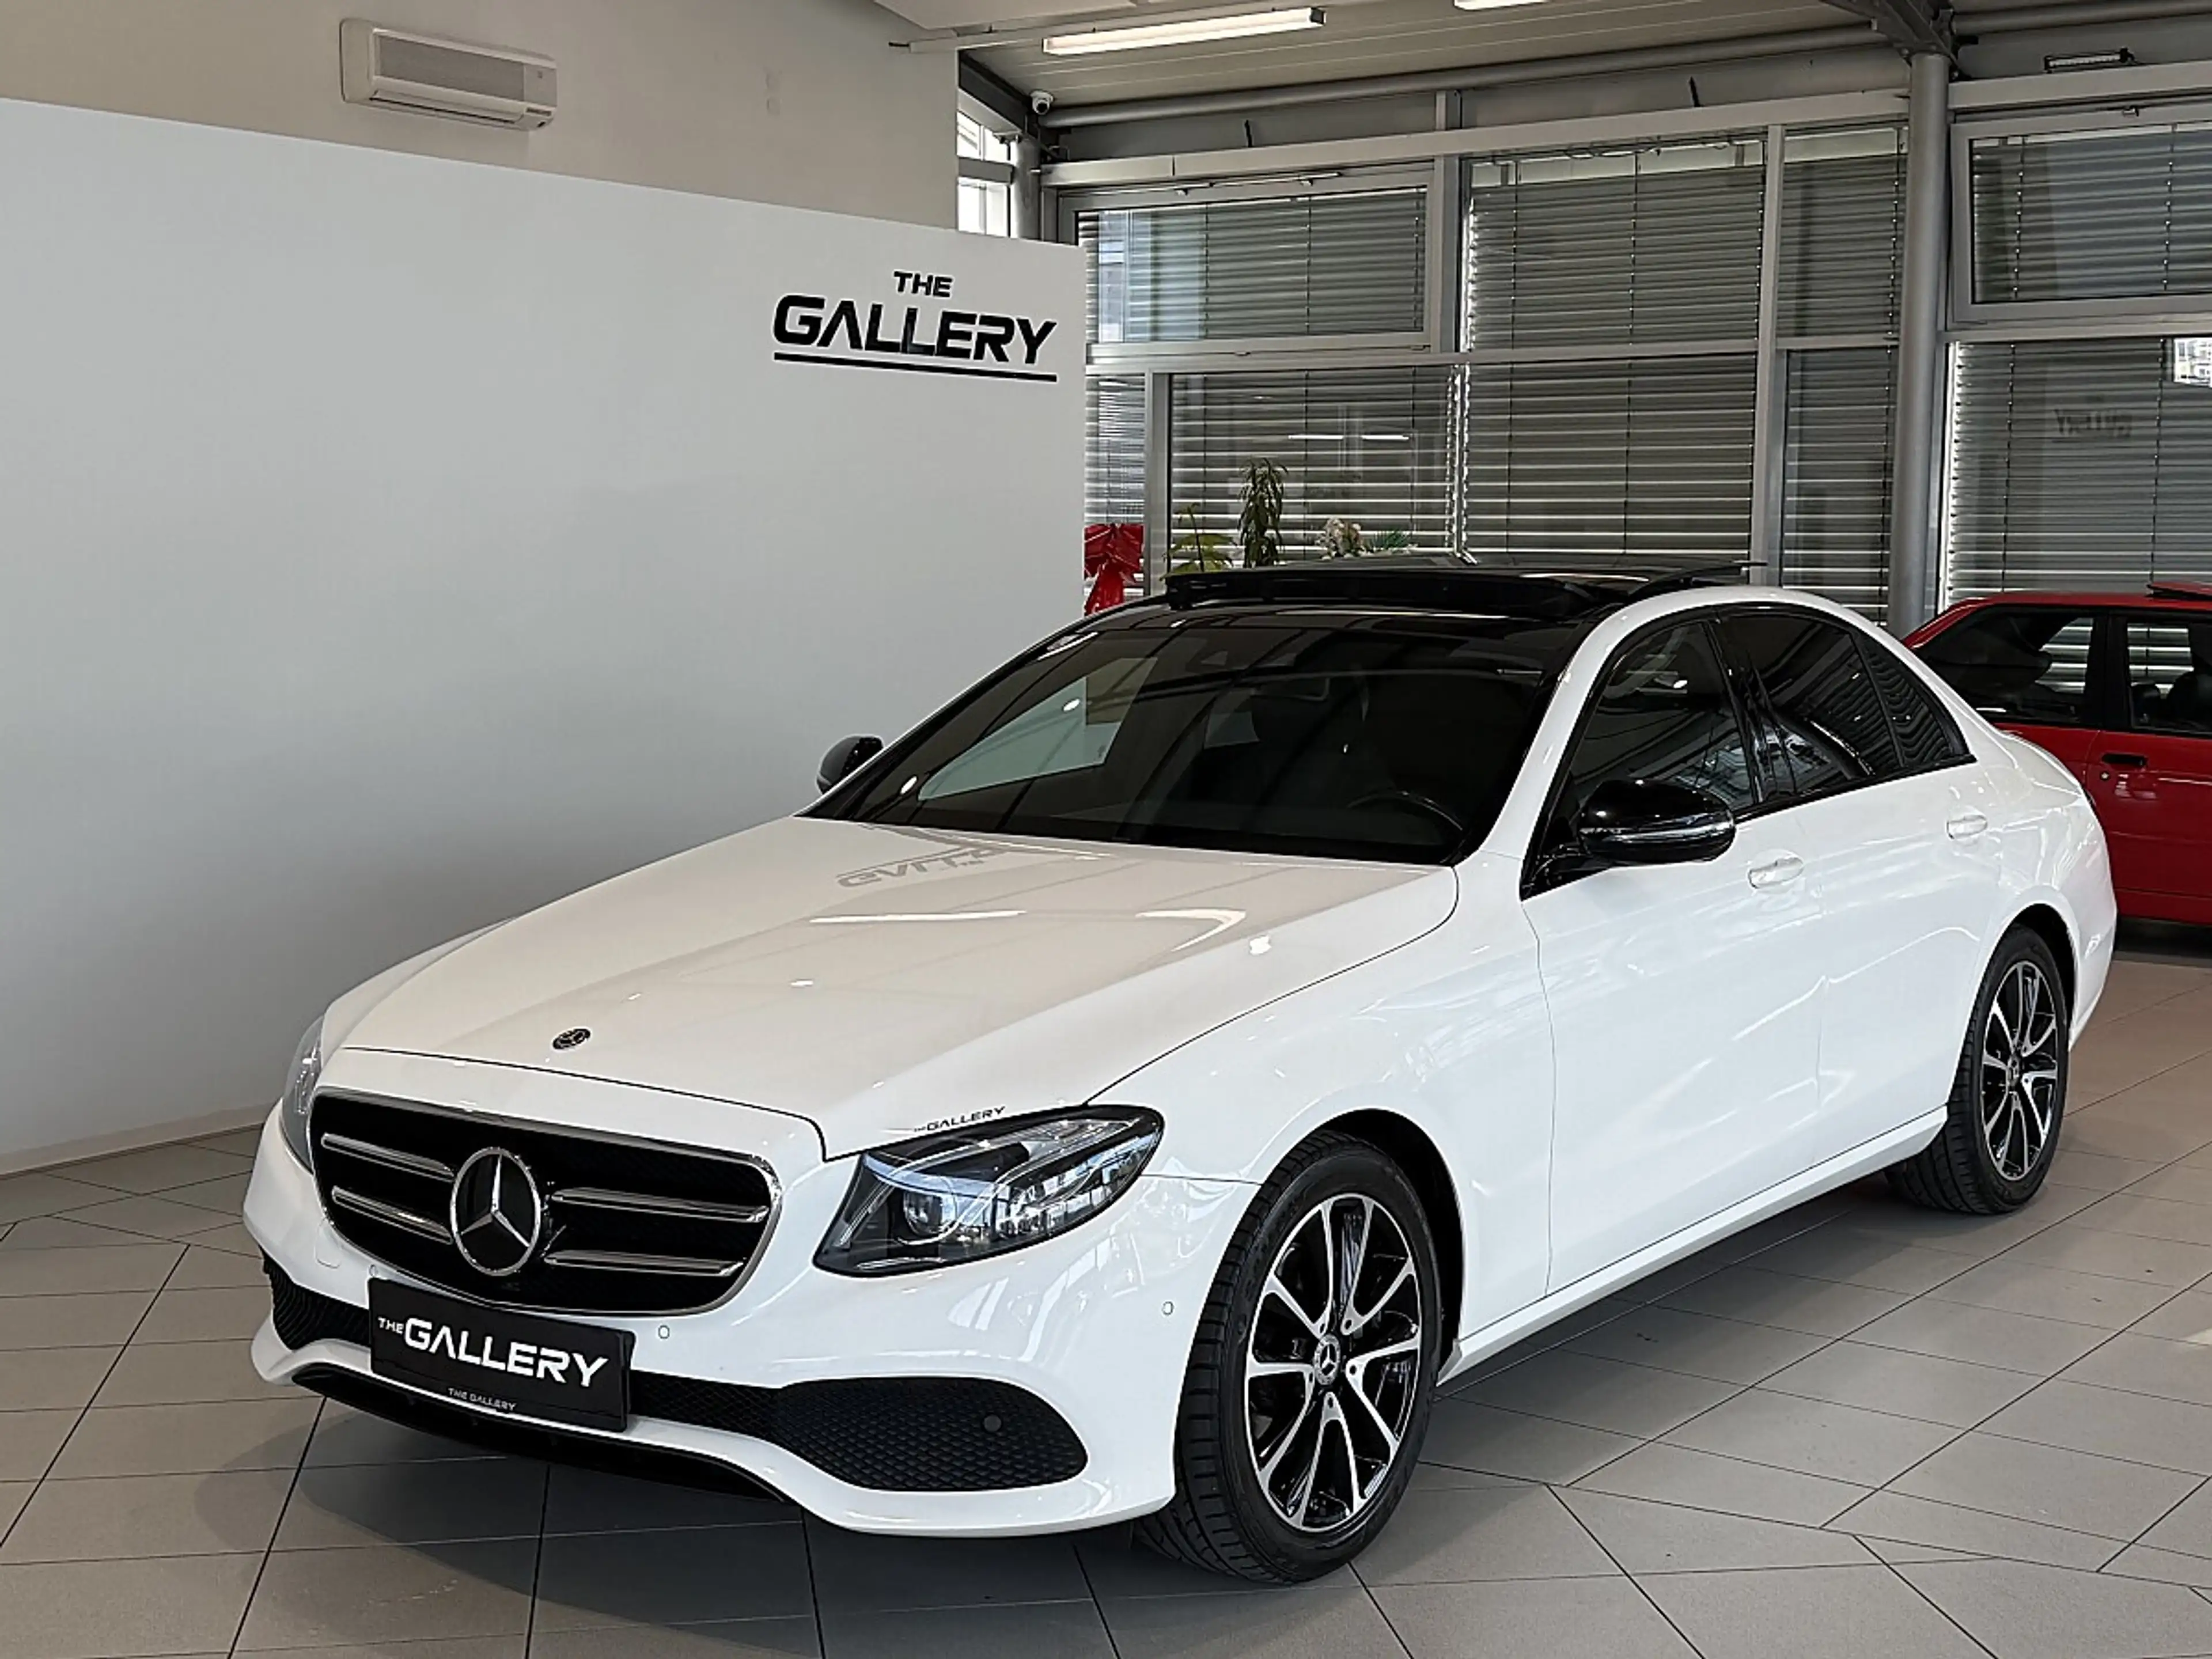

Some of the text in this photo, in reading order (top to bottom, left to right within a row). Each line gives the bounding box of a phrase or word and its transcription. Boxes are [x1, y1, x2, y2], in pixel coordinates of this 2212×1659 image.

[893, 270, 953, 298] THE
[773, 294, 1058, 365] GALLERY
[926, 1105, 1006, 1131] GALLERY
[378, 1317, 609, 1388] THE GALLERY
[448, 1387, 517, 1411] THE GALLERY
